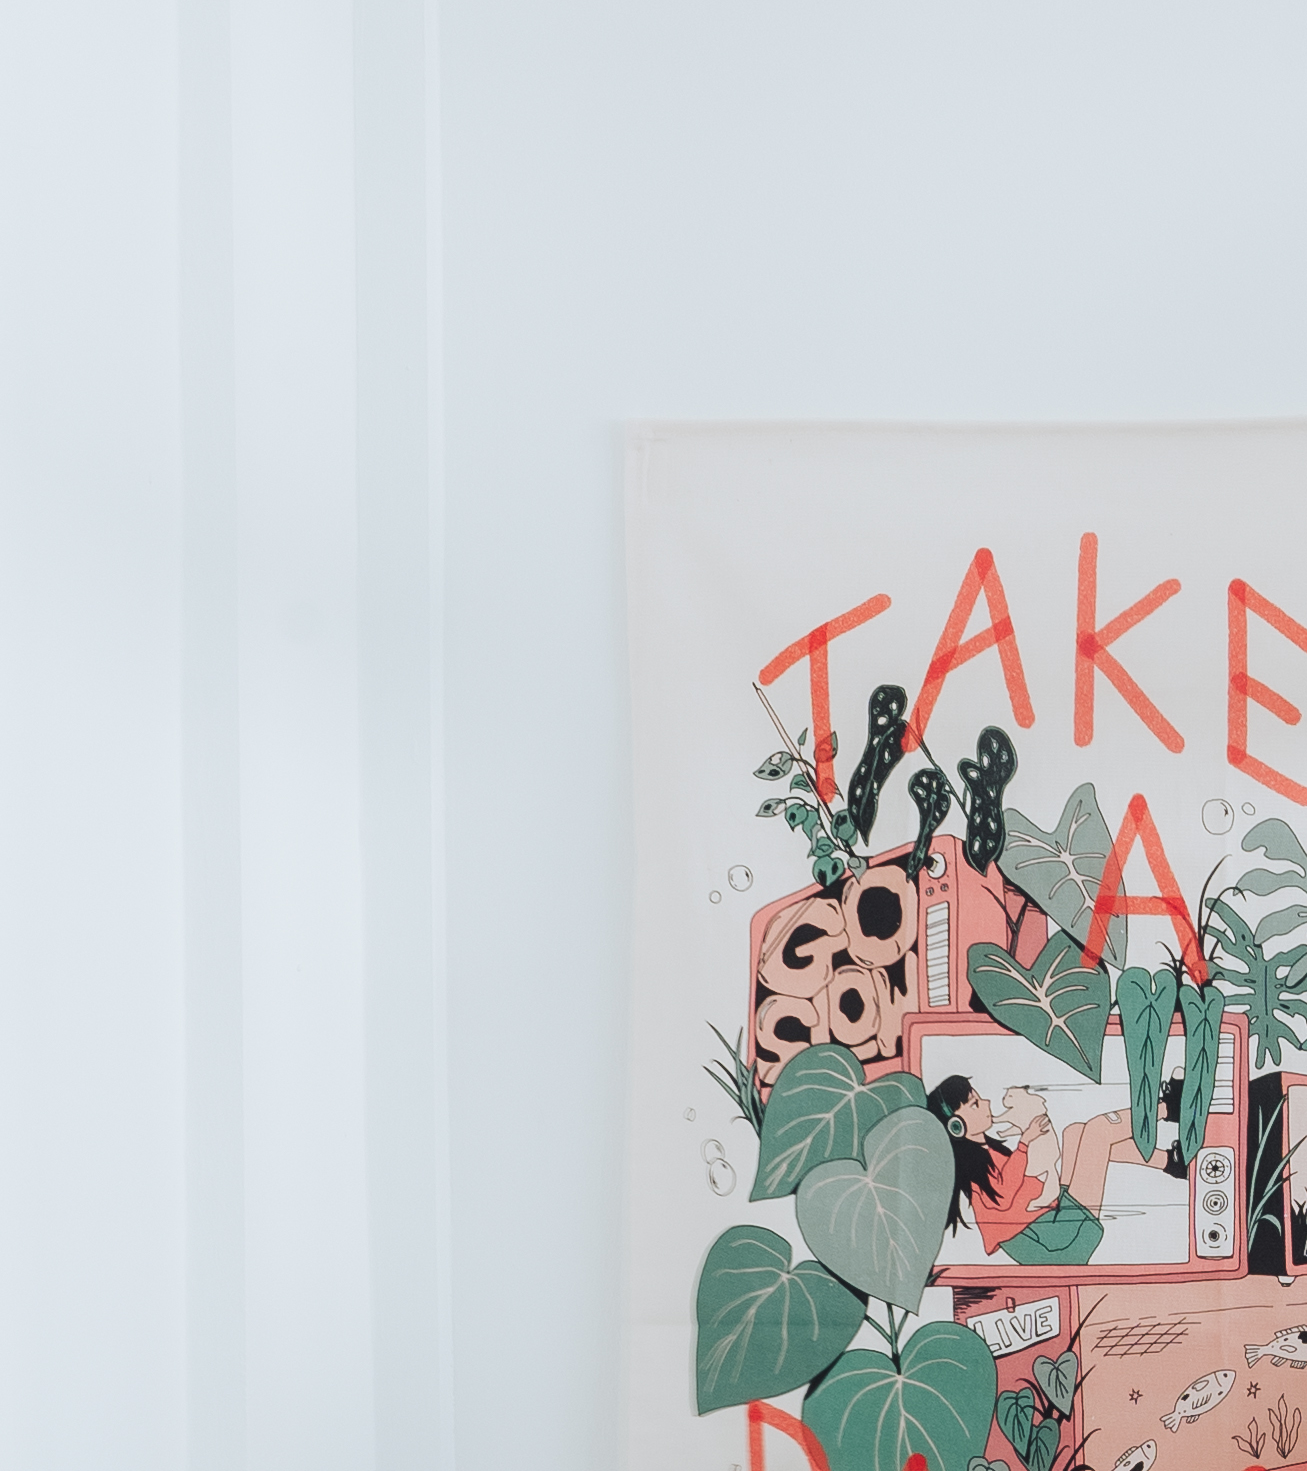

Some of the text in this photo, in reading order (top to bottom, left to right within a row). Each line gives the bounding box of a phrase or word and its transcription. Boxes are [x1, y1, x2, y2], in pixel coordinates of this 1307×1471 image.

[758, 863, 918, 998] GO
[1080, 793, 1210, 983] A
[973, 1305, 1054, 1354] LIVE
